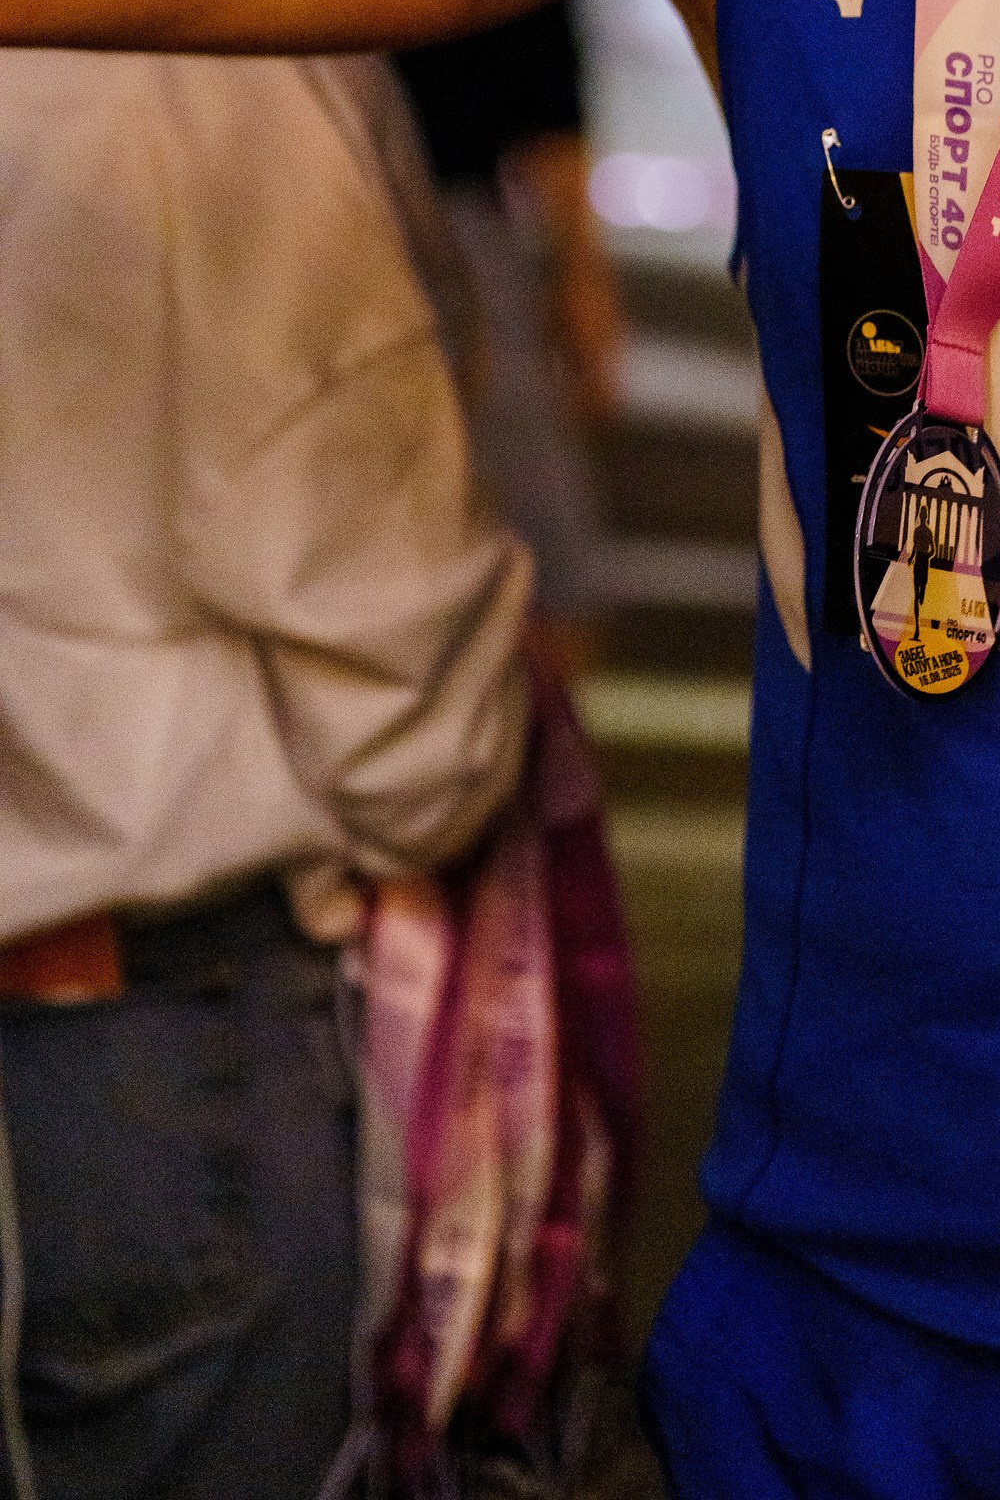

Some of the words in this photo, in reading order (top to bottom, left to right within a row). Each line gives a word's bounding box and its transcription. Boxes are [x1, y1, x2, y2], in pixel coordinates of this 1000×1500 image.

[976, 54, 994, 105] PRO
[942, 51, 973, 192] СПОРТ
[927, 134, 940, 171] БУДЬ
[941, 198, 965, 251] 40
[946, 627, 975, 642] СПОРТ
